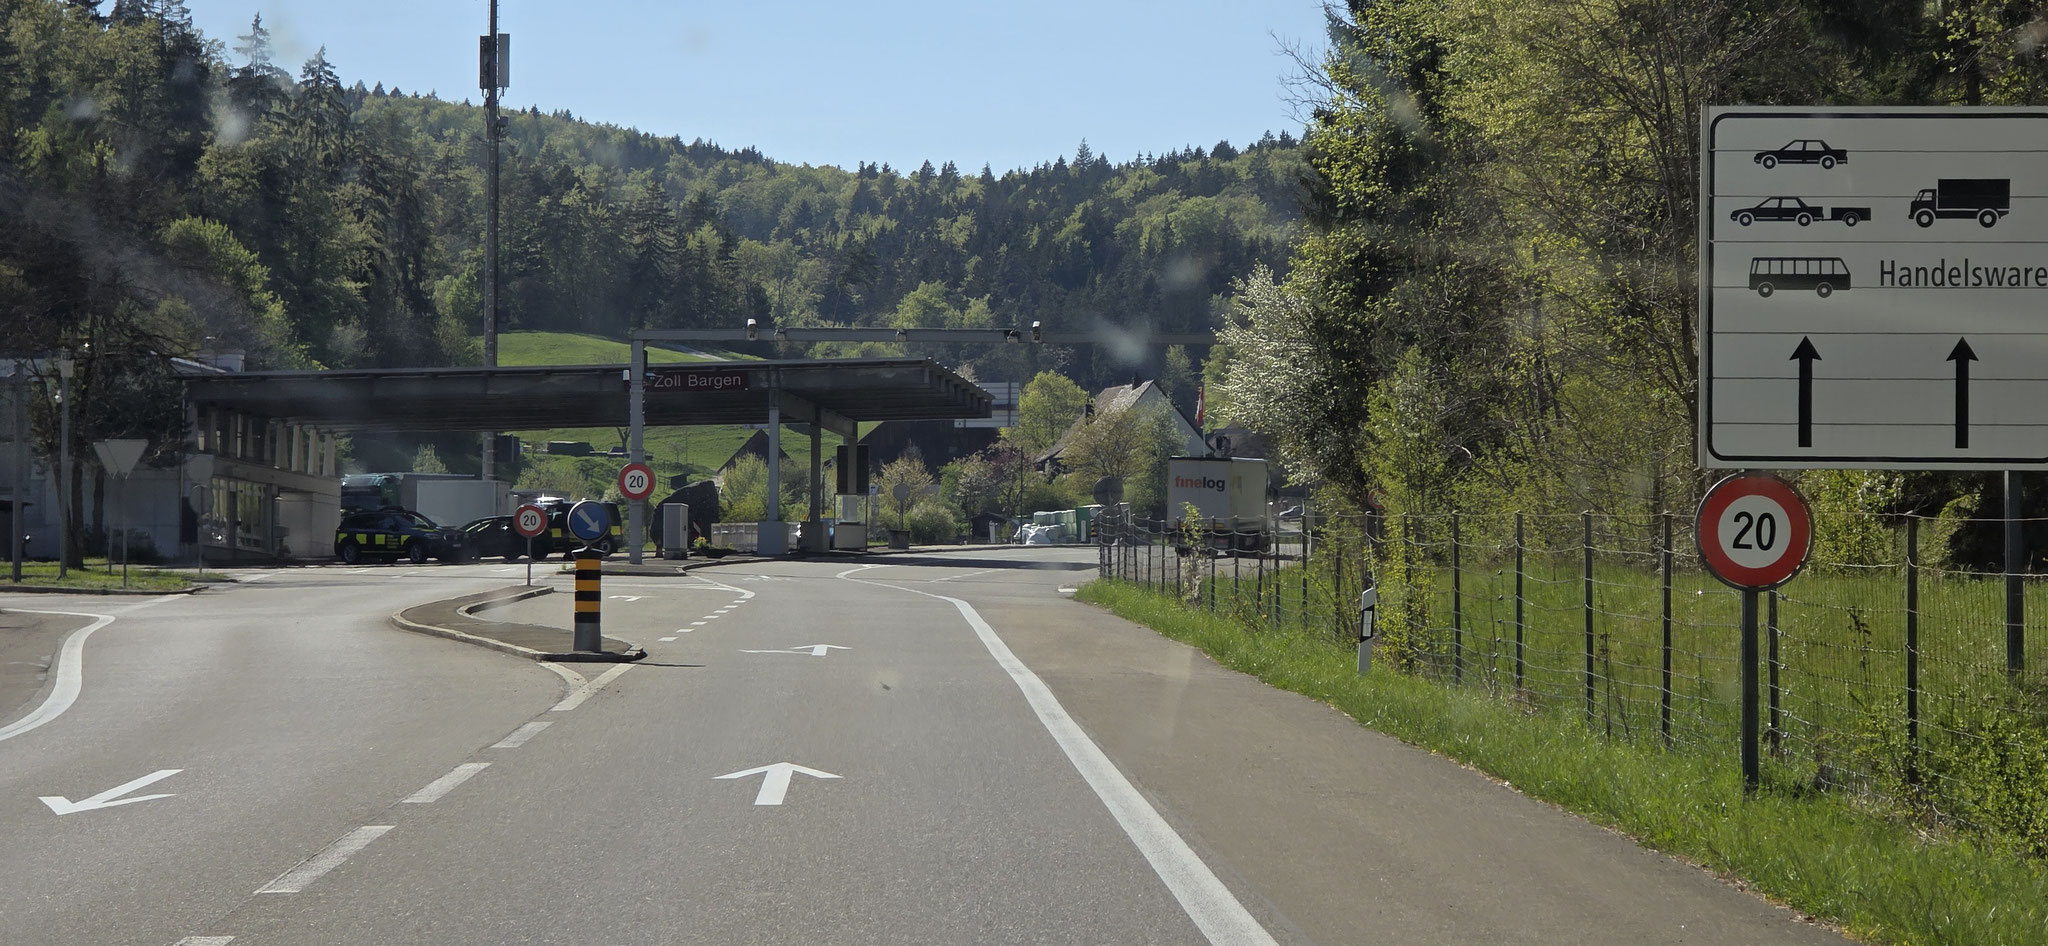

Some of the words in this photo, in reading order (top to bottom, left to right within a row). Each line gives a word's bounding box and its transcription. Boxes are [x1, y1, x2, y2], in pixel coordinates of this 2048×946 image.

[654, 374, 681, 388] Zoll
[688, 374, 741, 390] Bargen
[629, 475, 644, 488] 20
[1175, 475, 1226, 492] finelog
[523, 515, 537, 527] 20
[1732, 511, 1777, 551] 20
